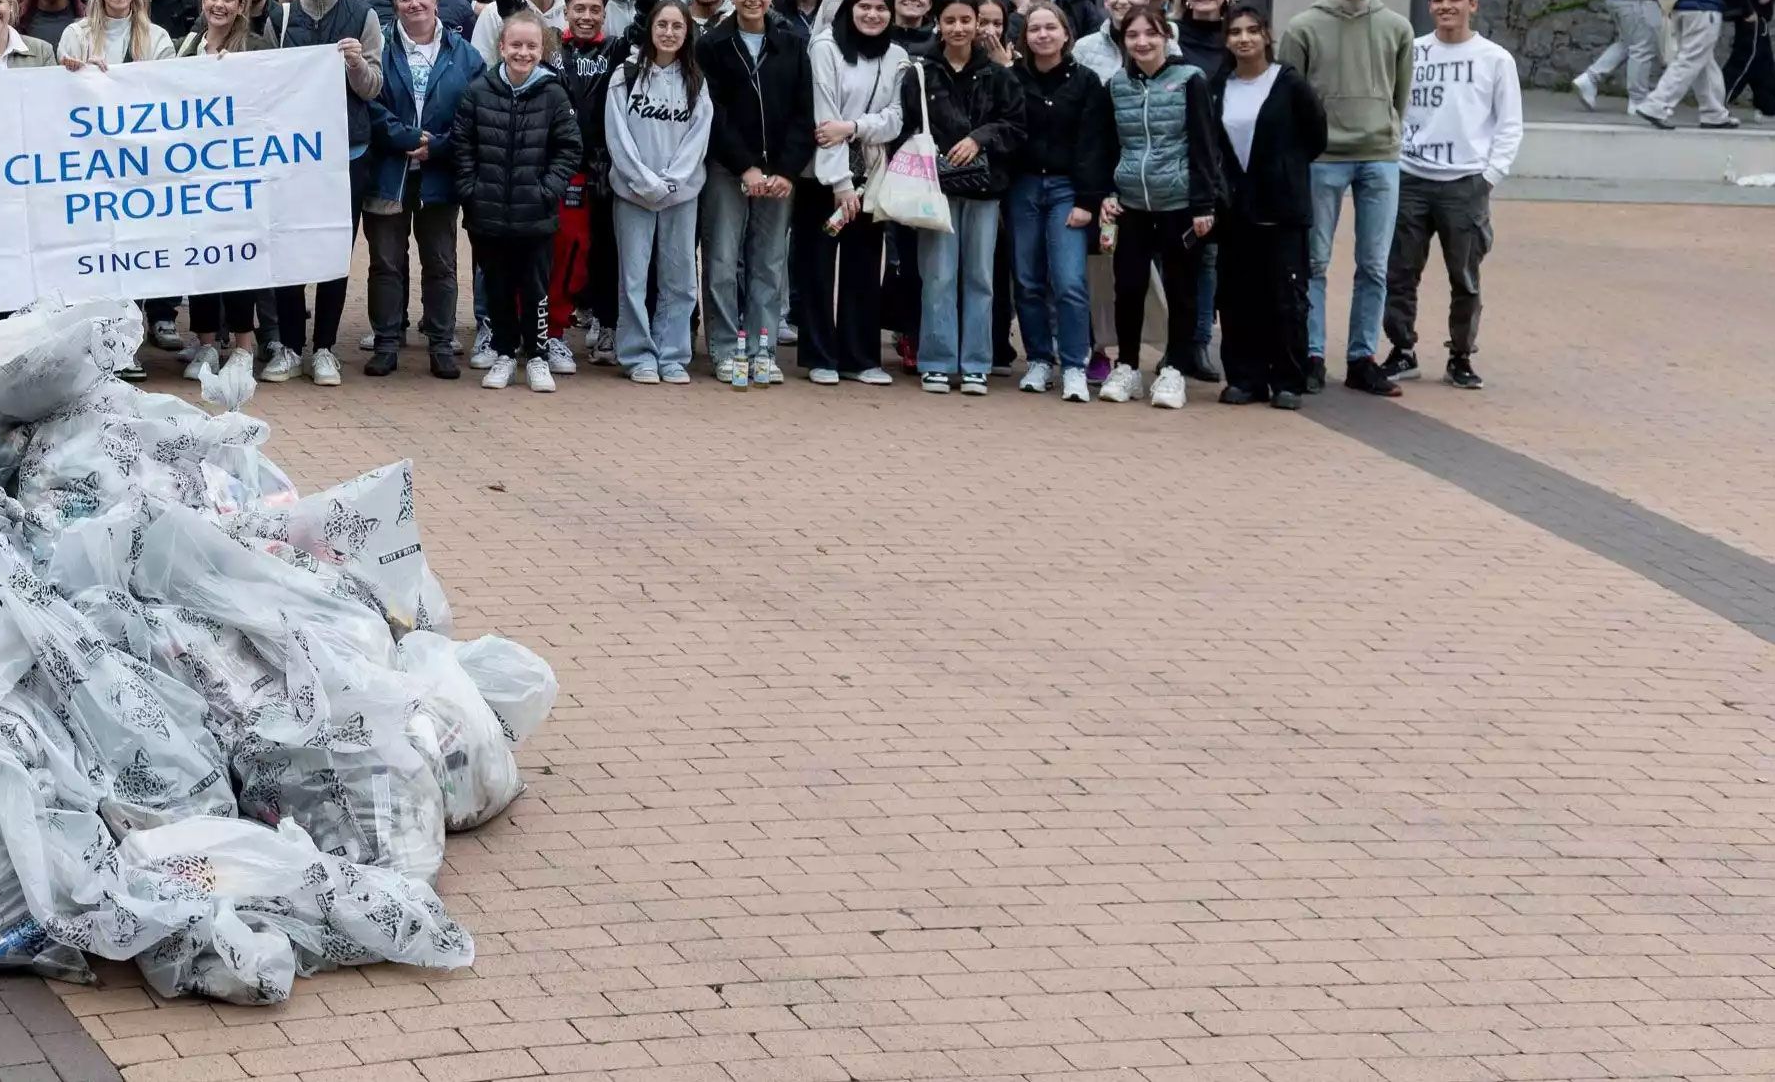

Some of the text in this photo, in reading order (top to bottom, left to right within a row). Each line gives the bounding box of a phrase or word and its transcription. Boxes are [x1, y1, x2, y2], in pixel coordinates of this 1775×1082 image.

[1413, 60, 1473, 82] GOTTI
[69, 96, 234, 138] SUZUKI
[1409, 86, 1444, 107] RIS
[4, 131, 322, 185] CLEAN OCEAN
[66, 179, 262, 224] PROJECT
[78, 242, 257, 275] SINCE 2010
[536, 295, 549, 350] KAPPA
